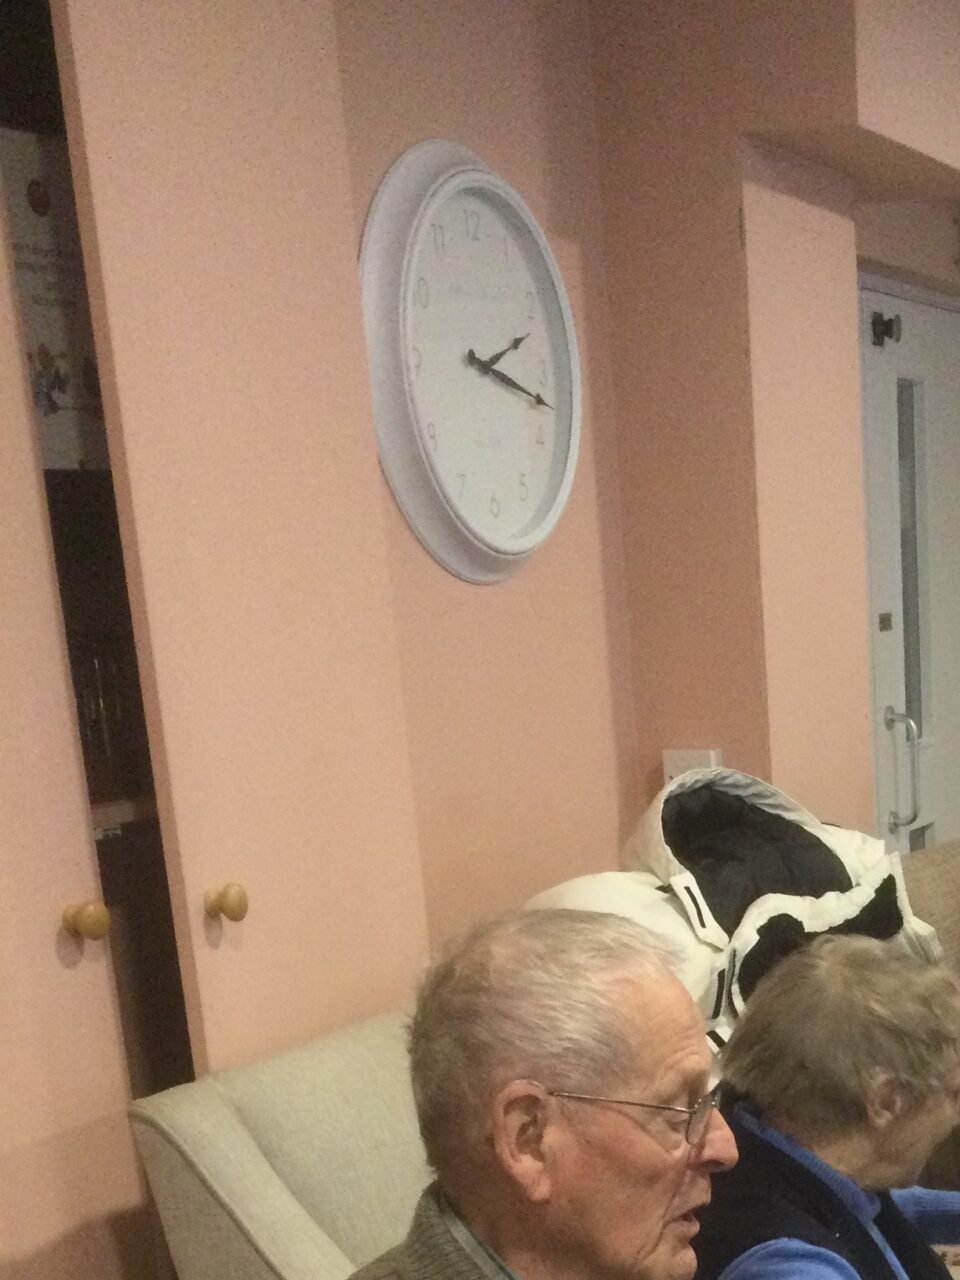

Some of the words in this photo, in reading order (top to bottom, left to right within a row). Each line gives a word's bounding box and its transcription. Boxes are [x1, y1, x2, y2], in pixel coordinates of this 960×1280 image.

[431, 223, 446, 253] 11
[462, 208, 480, 241] 12
[525, 290, 535, 320] 2
[539, 358, 549, 389] 3
[427, 422, 438, 452] 8
[456, 472, 467, 502] 7
[519, 472, 529, 502] 5
[489, 489, 501, 519] 6
